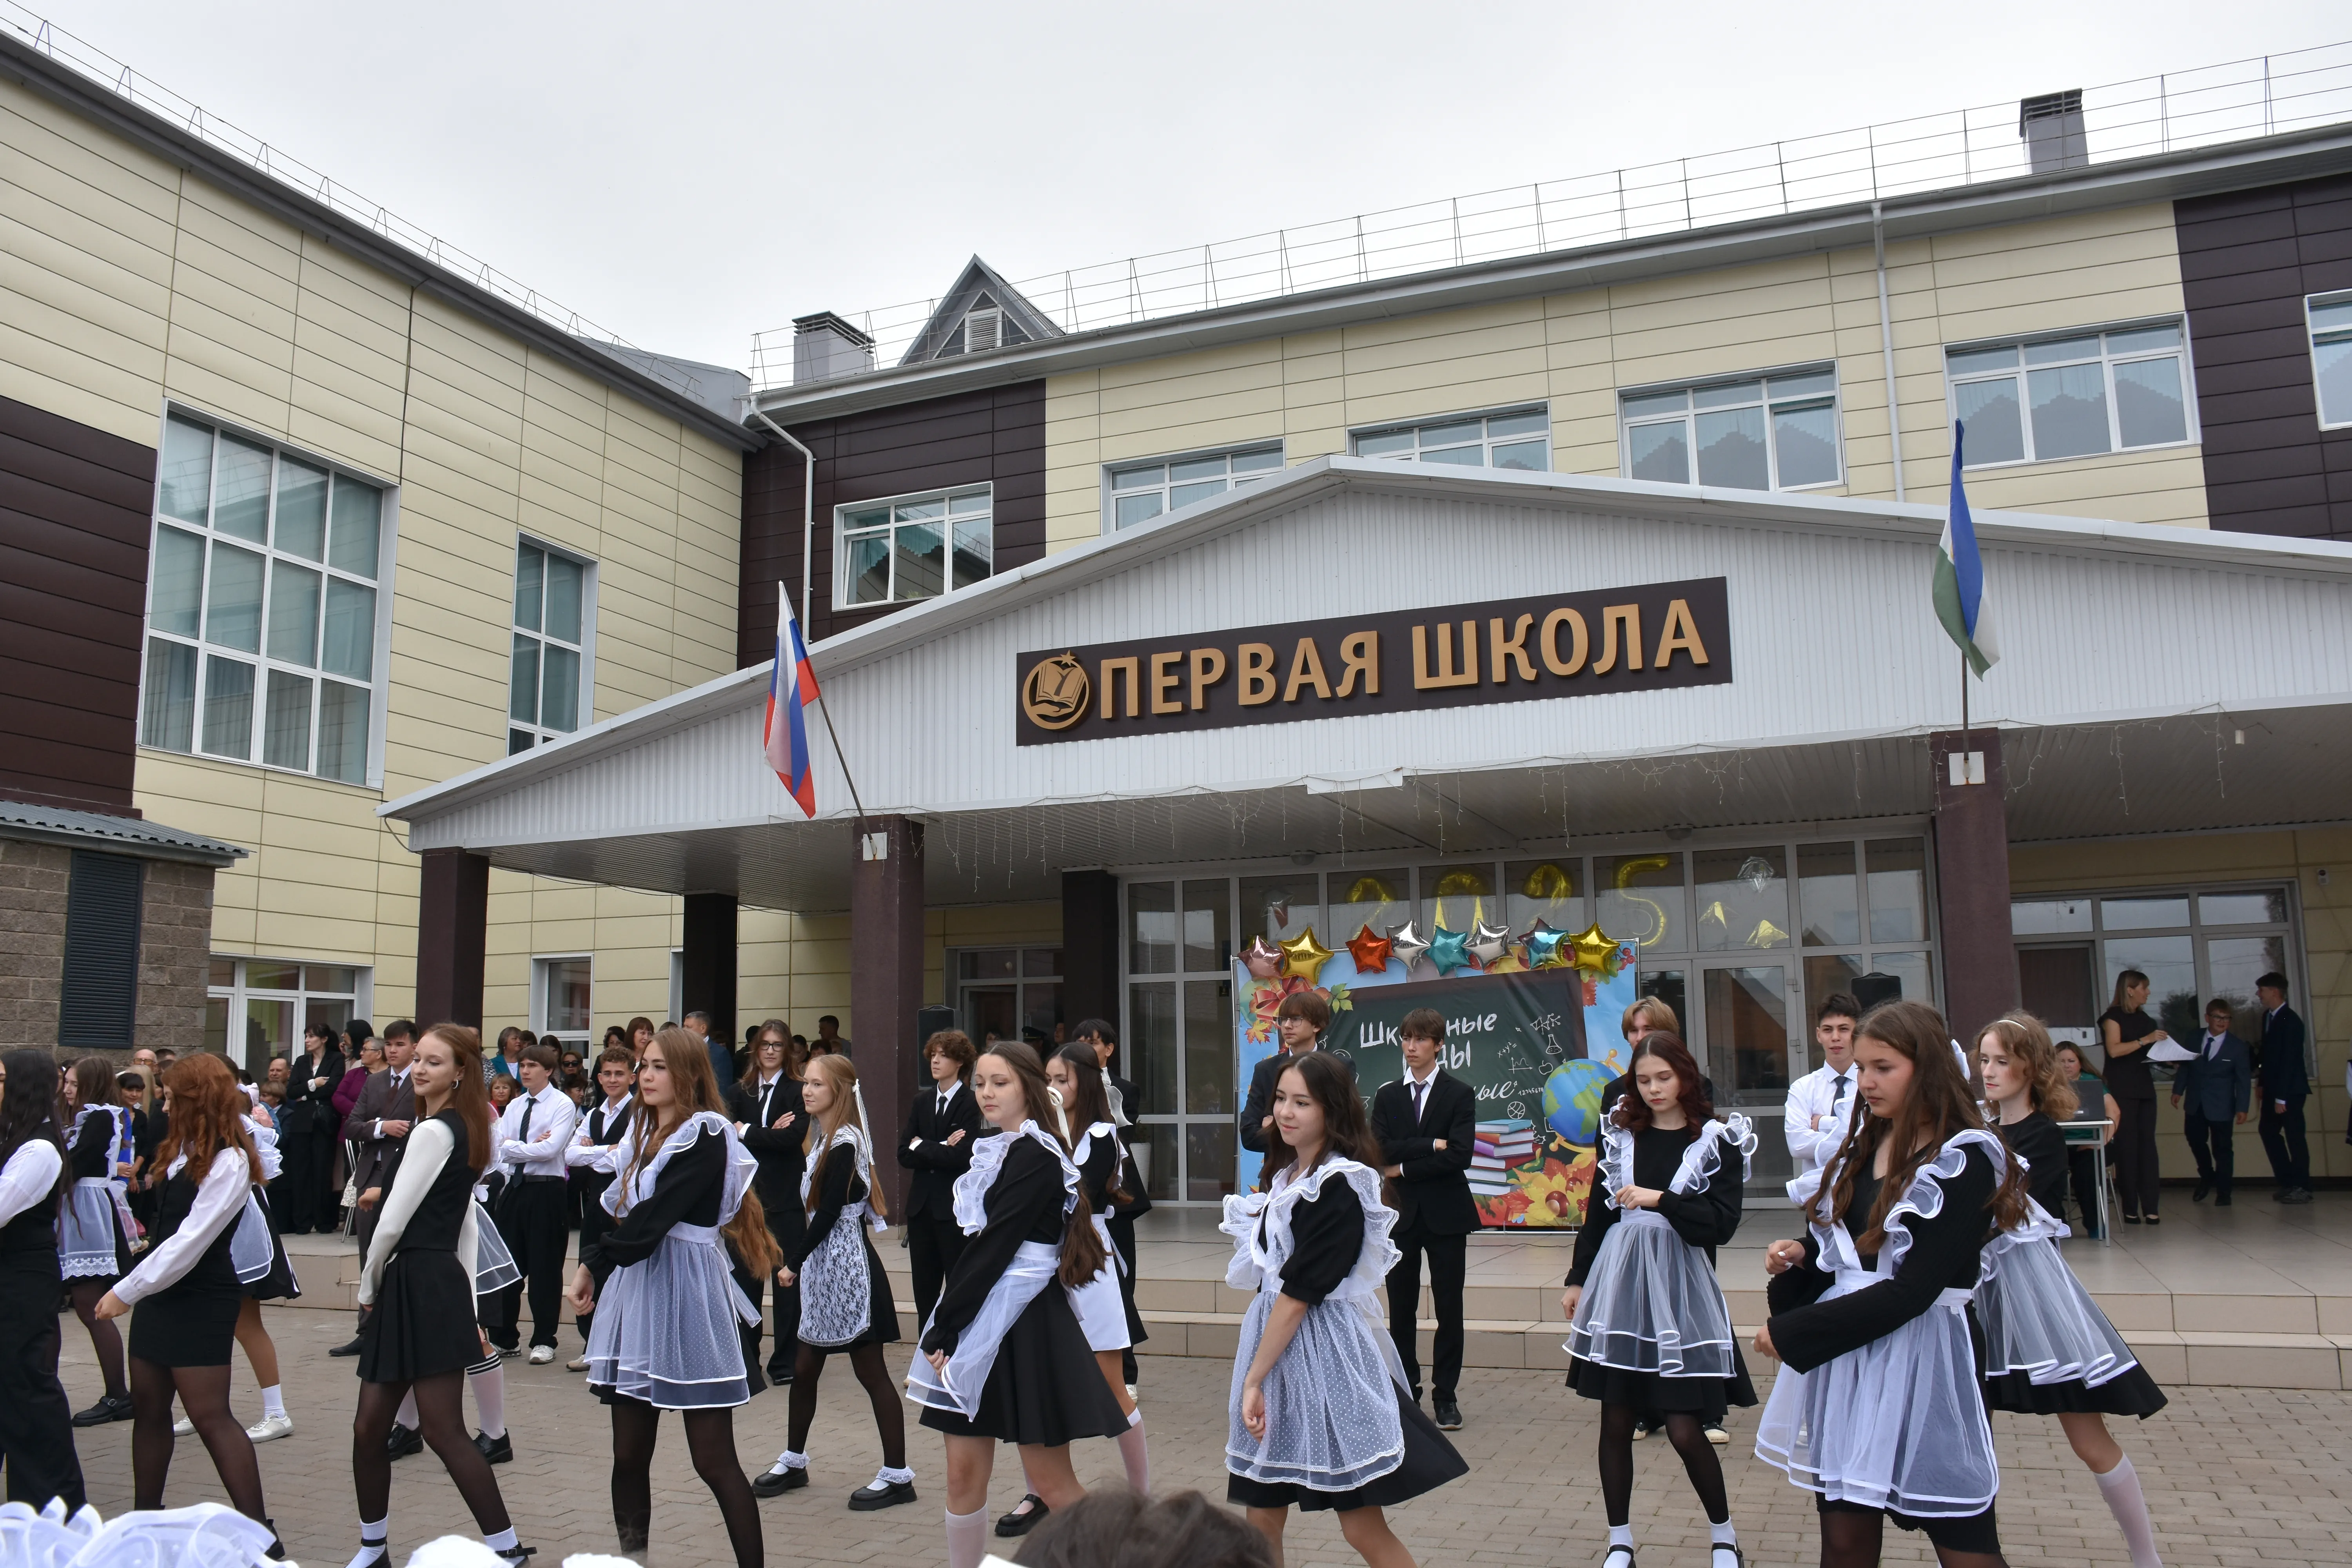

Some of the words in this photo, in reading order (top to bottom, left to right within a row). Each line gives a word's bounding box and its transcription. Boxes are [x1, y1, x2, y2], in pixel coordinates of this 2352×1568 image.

[1100, 630, 1379, 719] ПЕРВАЯ
[1412, 599, 1709, 690] ШКОЛА
[1360, 1013, 1497, 1048] Шкные
